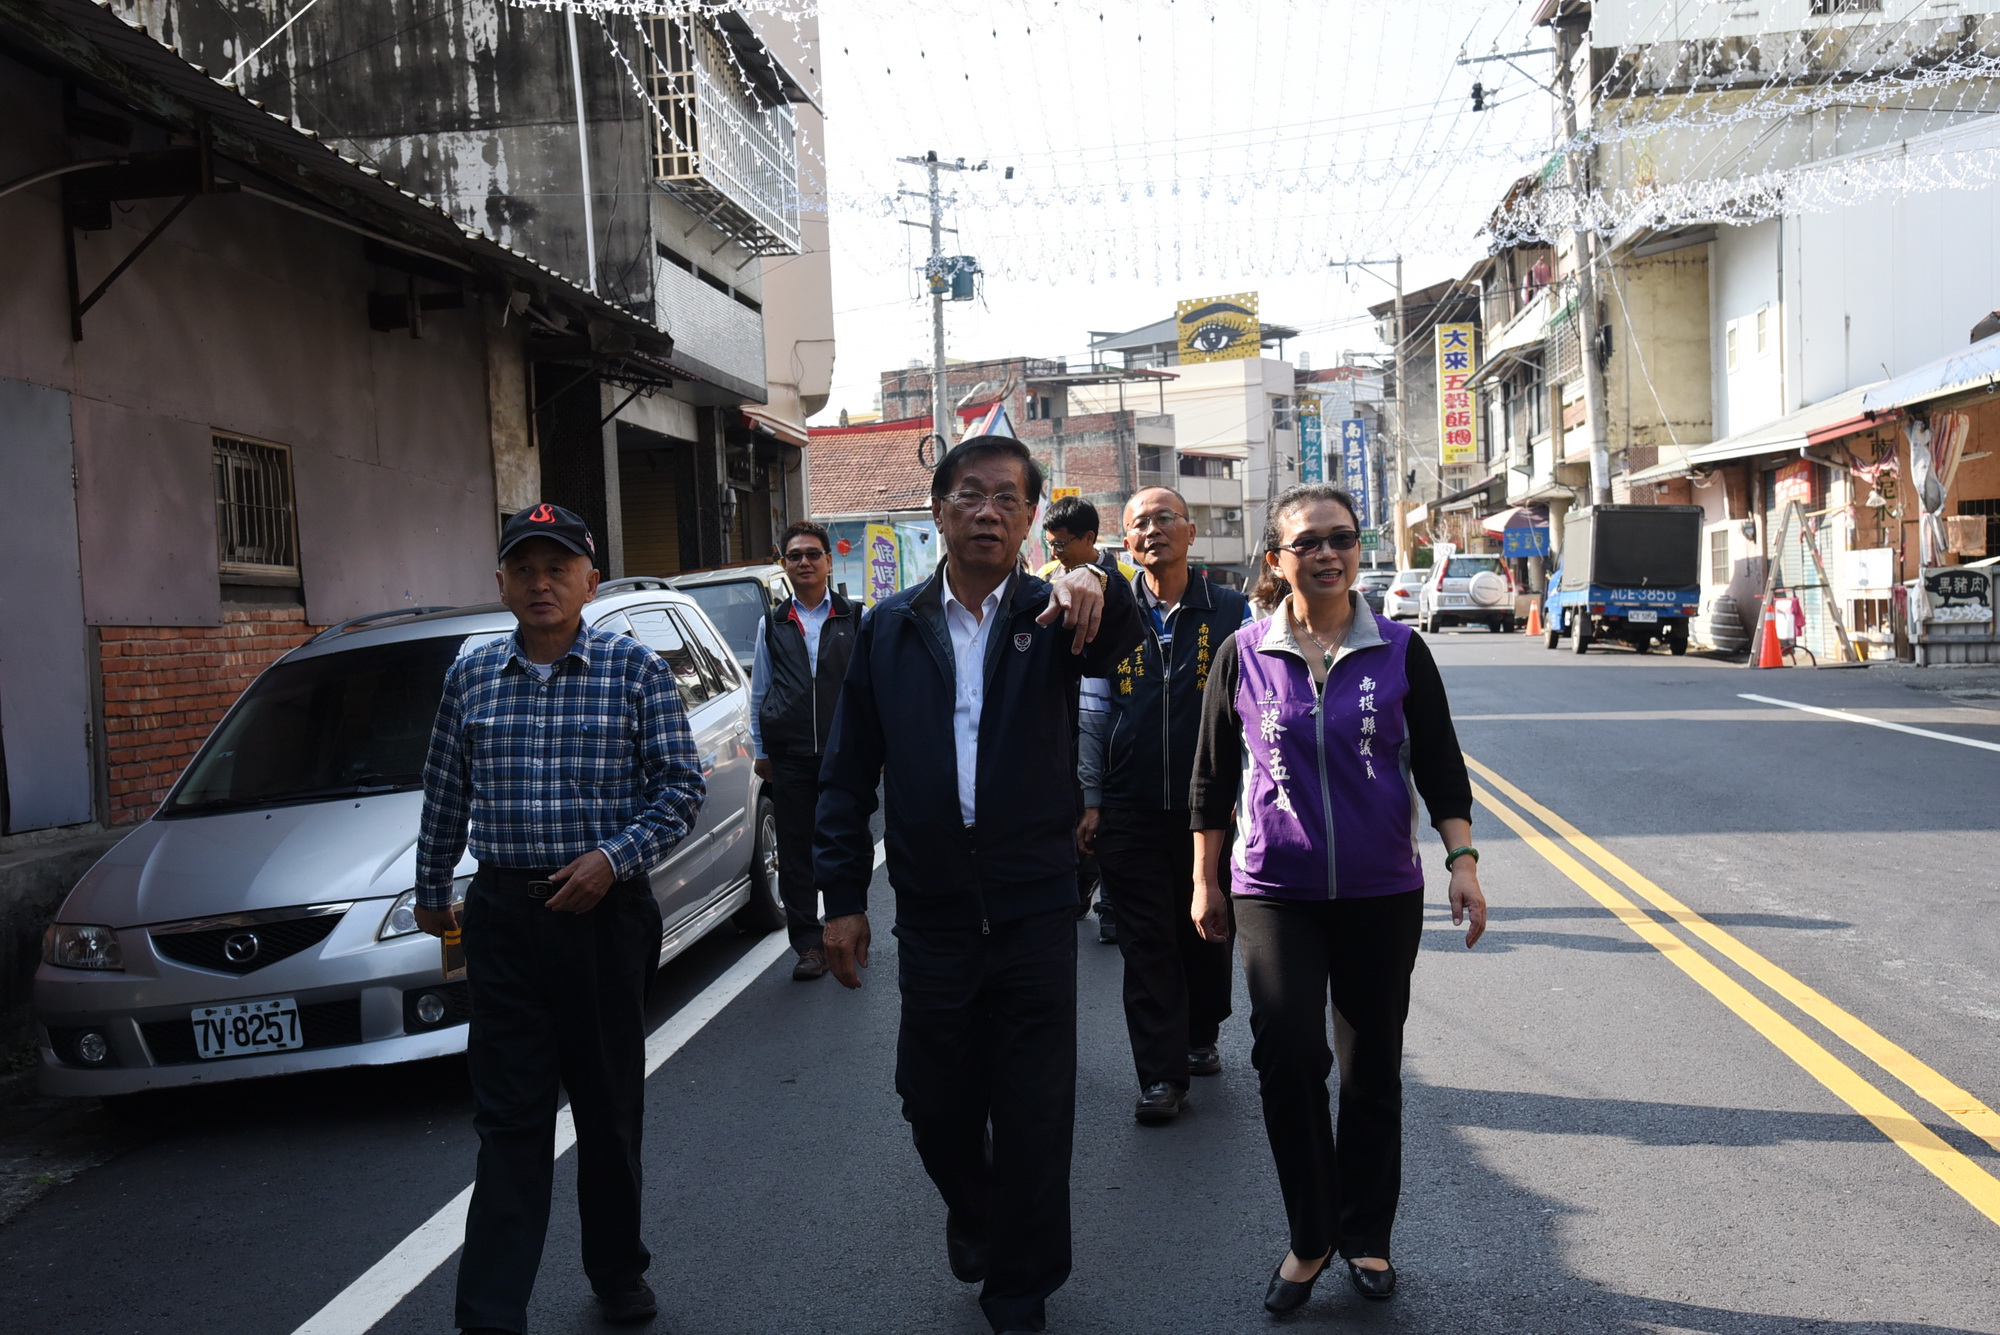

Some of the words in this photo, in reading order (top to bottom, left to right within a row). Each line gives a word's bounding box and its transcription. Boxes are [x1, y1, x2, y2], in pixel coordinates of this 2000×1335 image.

[1443, 329, 1472, 446] 大來五穀飯糰
[1938, 575, 1984, 594] 黑豬肉
[1358, 675, 1378, 780] 南投縣議員
[224, 1003, 263, 1016] 台灣省
